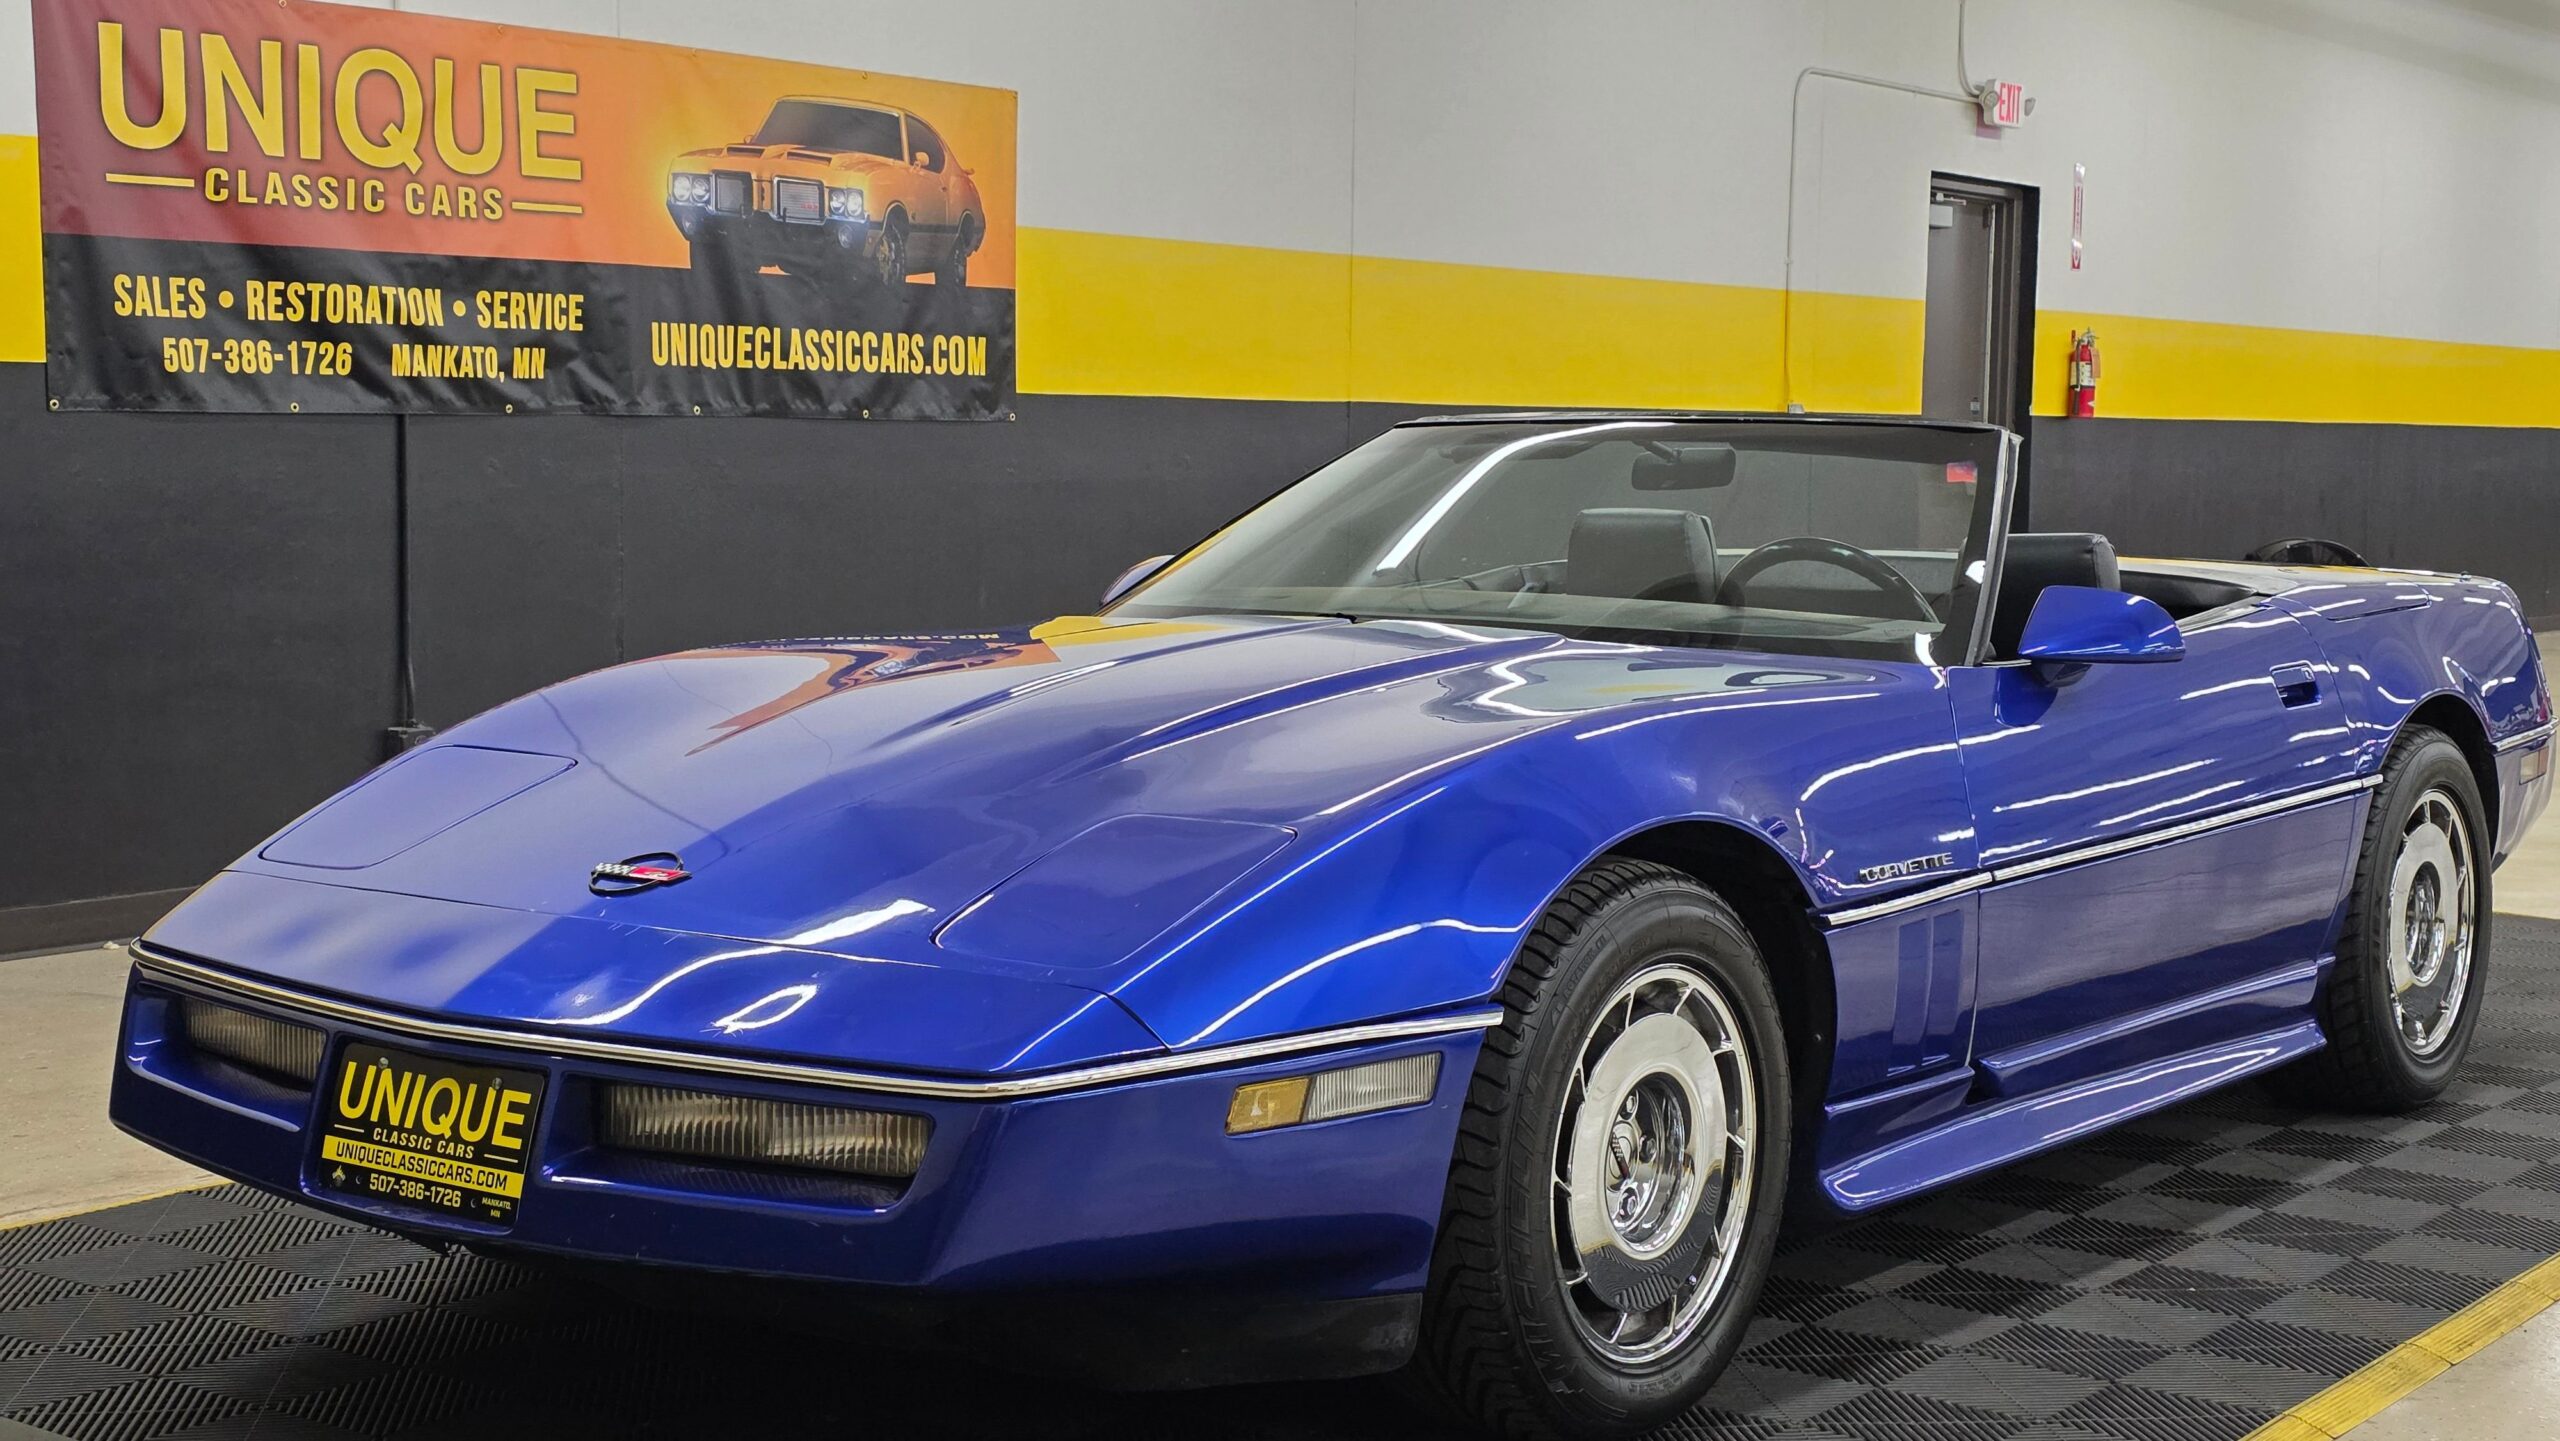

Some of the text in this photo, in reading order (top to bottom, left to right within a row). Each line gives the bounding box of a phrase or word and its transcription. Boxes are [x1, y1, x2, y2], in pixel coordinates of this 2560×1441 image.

[98, 21, 582, 181] UNIQUE
[1999, 82, 2022, 124] EXIT
[205, 168, 503, 220] CLASSIC CARS
[113, 274, 584, 332] SALES RESTORATION SERVICE
[163, 337, 545, 383] 507-386-1726 MANKATO, MN
[651, 321, 987, 377] UNIQUECLASSICCARS.COM
[1864, 852, 1955, 882] CORVETTE
[339, 1060, 532, 1150] UNIQUE
[336, 1140, 508, 1191] UNIQUECLASSICCARS.COM
[373, 1127, 475, 1160] CLASSIC CARS
[369, 1173, 462, 1208] 507-386-1726
